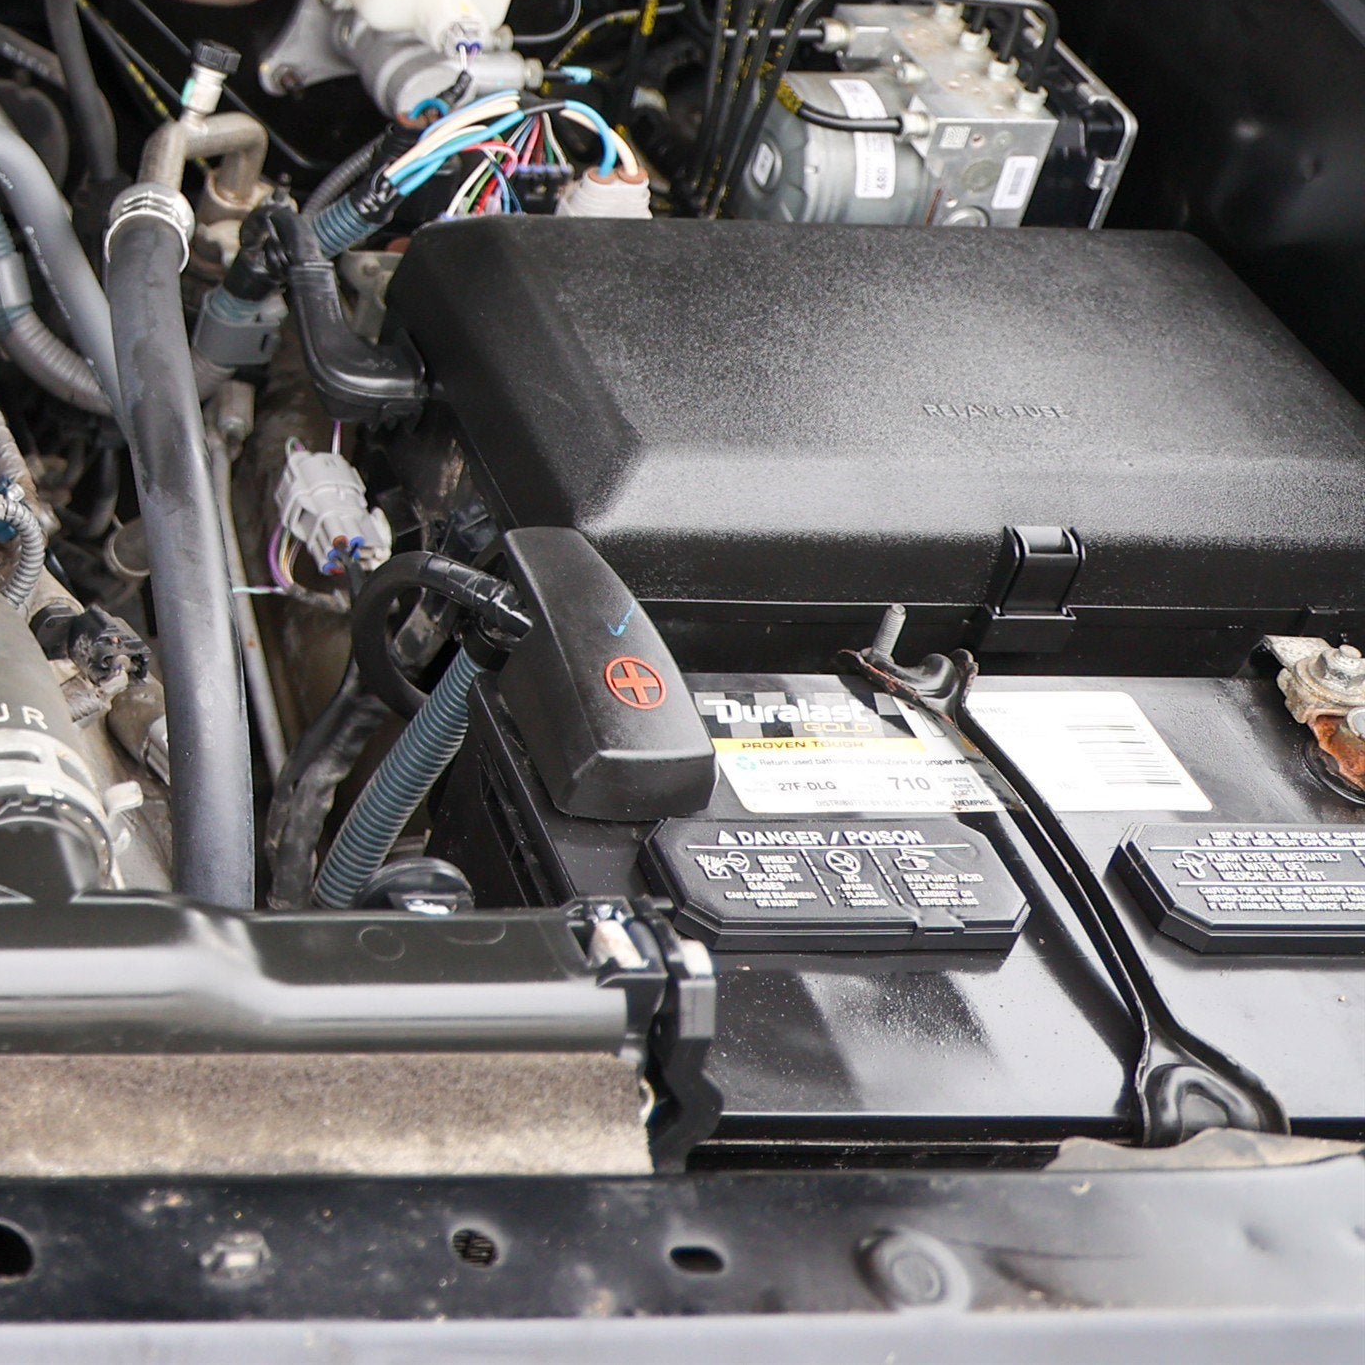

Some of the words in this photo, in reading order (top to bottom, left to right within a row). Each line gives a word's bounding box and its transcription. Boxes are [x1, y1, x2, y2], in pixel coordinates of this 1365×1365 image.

[922, 403, 989, 418] RELAY
[1012, 404, 1071, 418] FUSE
[703, 698, 869, 724] Duralast
[803, 722, 873, 733] GOLD
[741, 740, 806, 749] PROVEN
[759, 758, 789, 766] Return
[792, 758, 813, 766] used
[925, 759, 953, 768] proper
[778, 781, 837, 791] 27F-DLG
[888, 777, 931, 791] 710
[735, 830, 827, 845] DANGER
[842, 830, 926, 845] POISON
[757, 855, 797, 864] SHIELD
[1242, 852, 1272, 862] EYES
[1272, 852, 1342, 862] IMMEDIATELY
[762, 864, 793, 873] EYES
[1212, 862, 1243, 871] WITH
[1284, 862, 1308, 871] GET
[741, 872, 804, 882] EXPLOSIVE
[842, 875, 861, 883] NO
[902, 874, 957, 883] SULFURIC
[958, 874, 984, 883] ACID
[1220, 871, 1269, 881] MEDICAL
[1269, 871, 1297, 881] HELP
[1298, 871, 1327, 881] FAST
[747, 882, 786, 891] GASES
